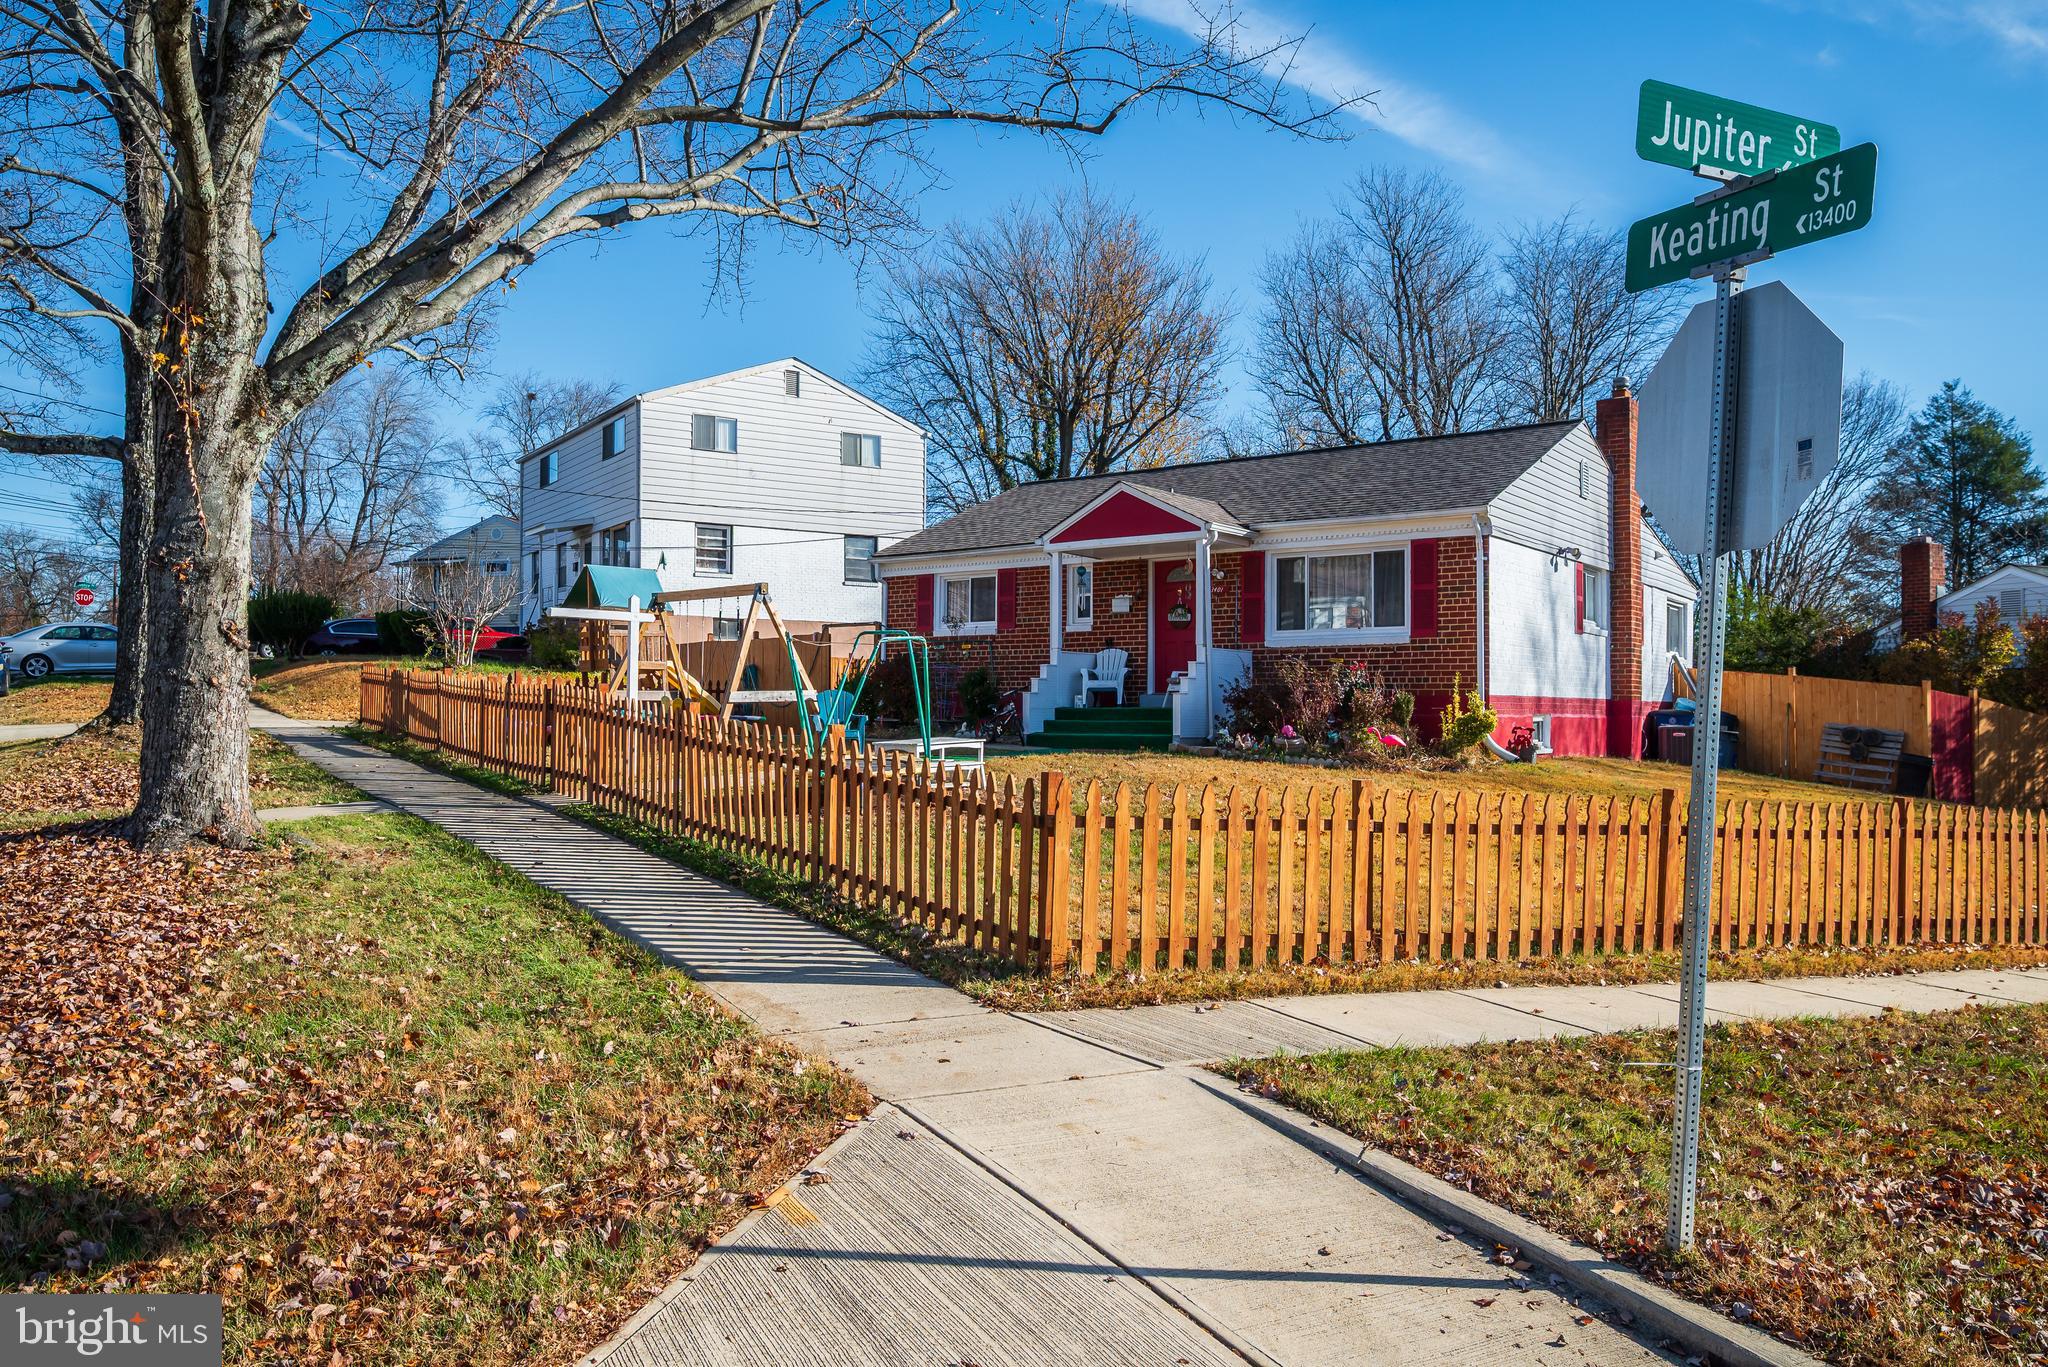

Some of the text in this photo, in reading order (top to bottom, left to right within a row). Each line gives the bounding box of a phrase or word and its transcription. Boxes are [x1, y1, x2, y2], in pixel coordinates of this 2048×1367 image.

[1651, 101, 1818, 168] Jupiter St
[1650, 164, 1843, 268] Keating St
[1808, 200, 1857, 232] 13400
[75, 593, 94, 602] STOP
